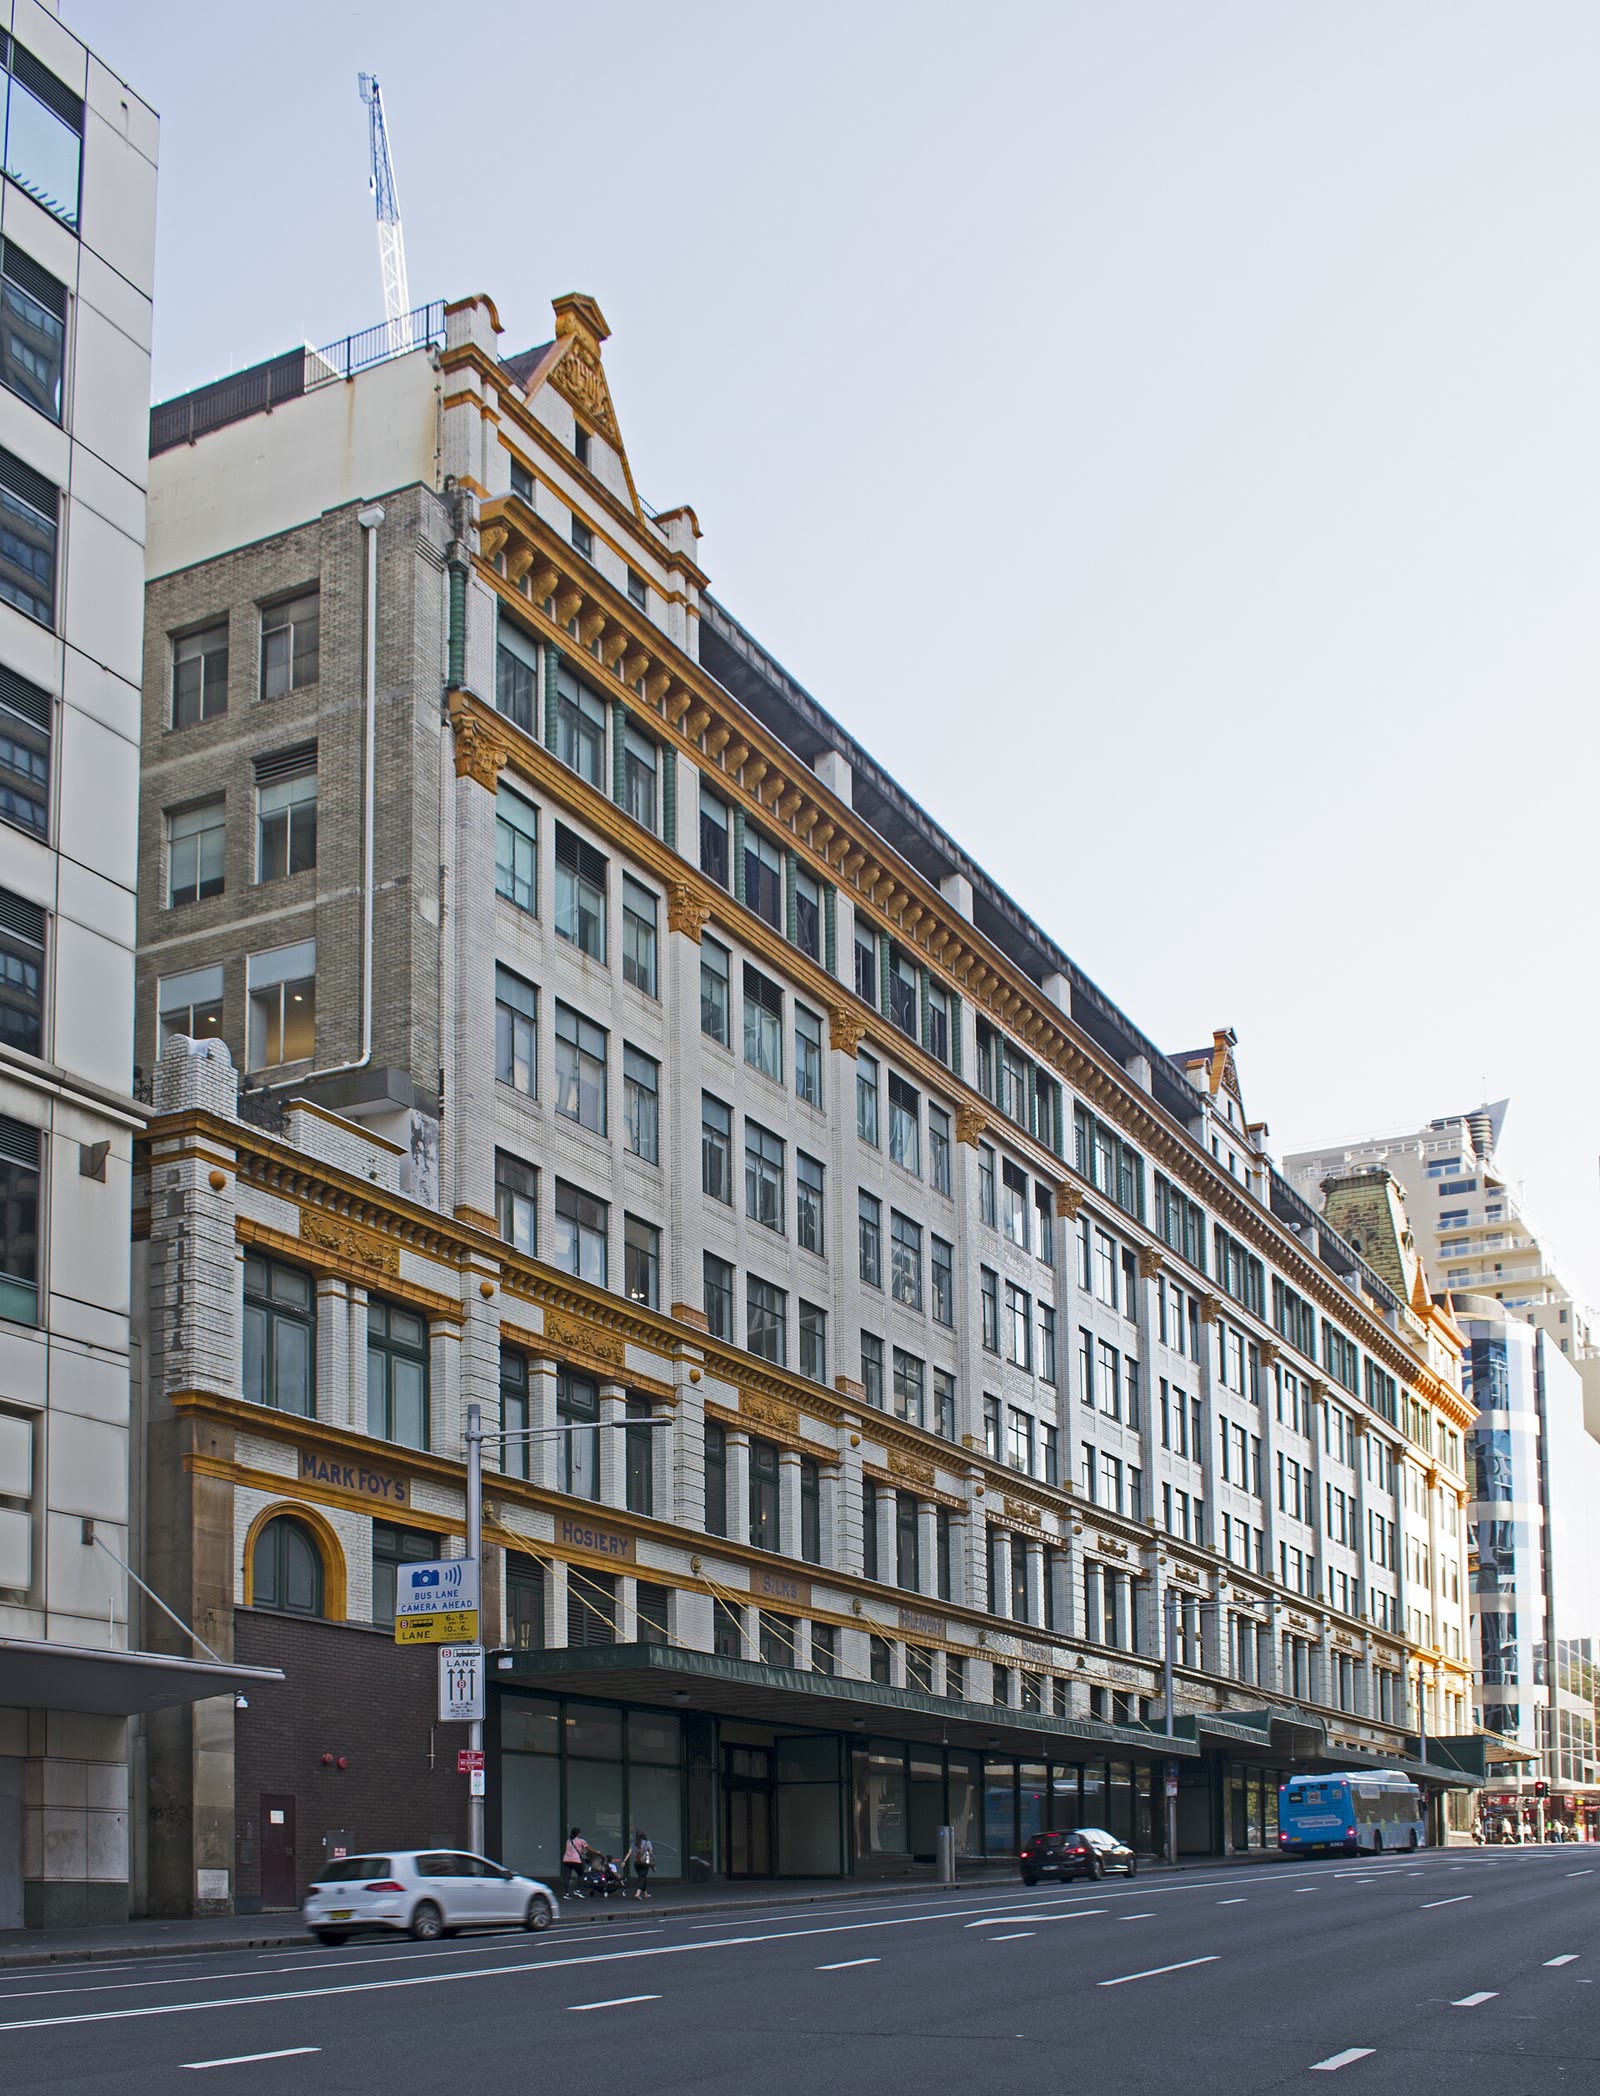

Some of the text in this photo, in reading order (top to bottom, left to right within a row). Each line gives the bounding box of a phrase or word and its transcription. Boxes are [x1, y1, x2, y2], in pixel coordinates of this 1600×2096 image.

[302, 1452, 355, 1488] MARK
[562, 1520, 629, 1555] HOSIERY
[414, 1589, 459, 1601] BUS LANE
[401, 1599, 473, 1613] CAMERA AHEAD
[402, 1630, 431, 1640] LANE
[446, 1659, 477, 1668] LANE
